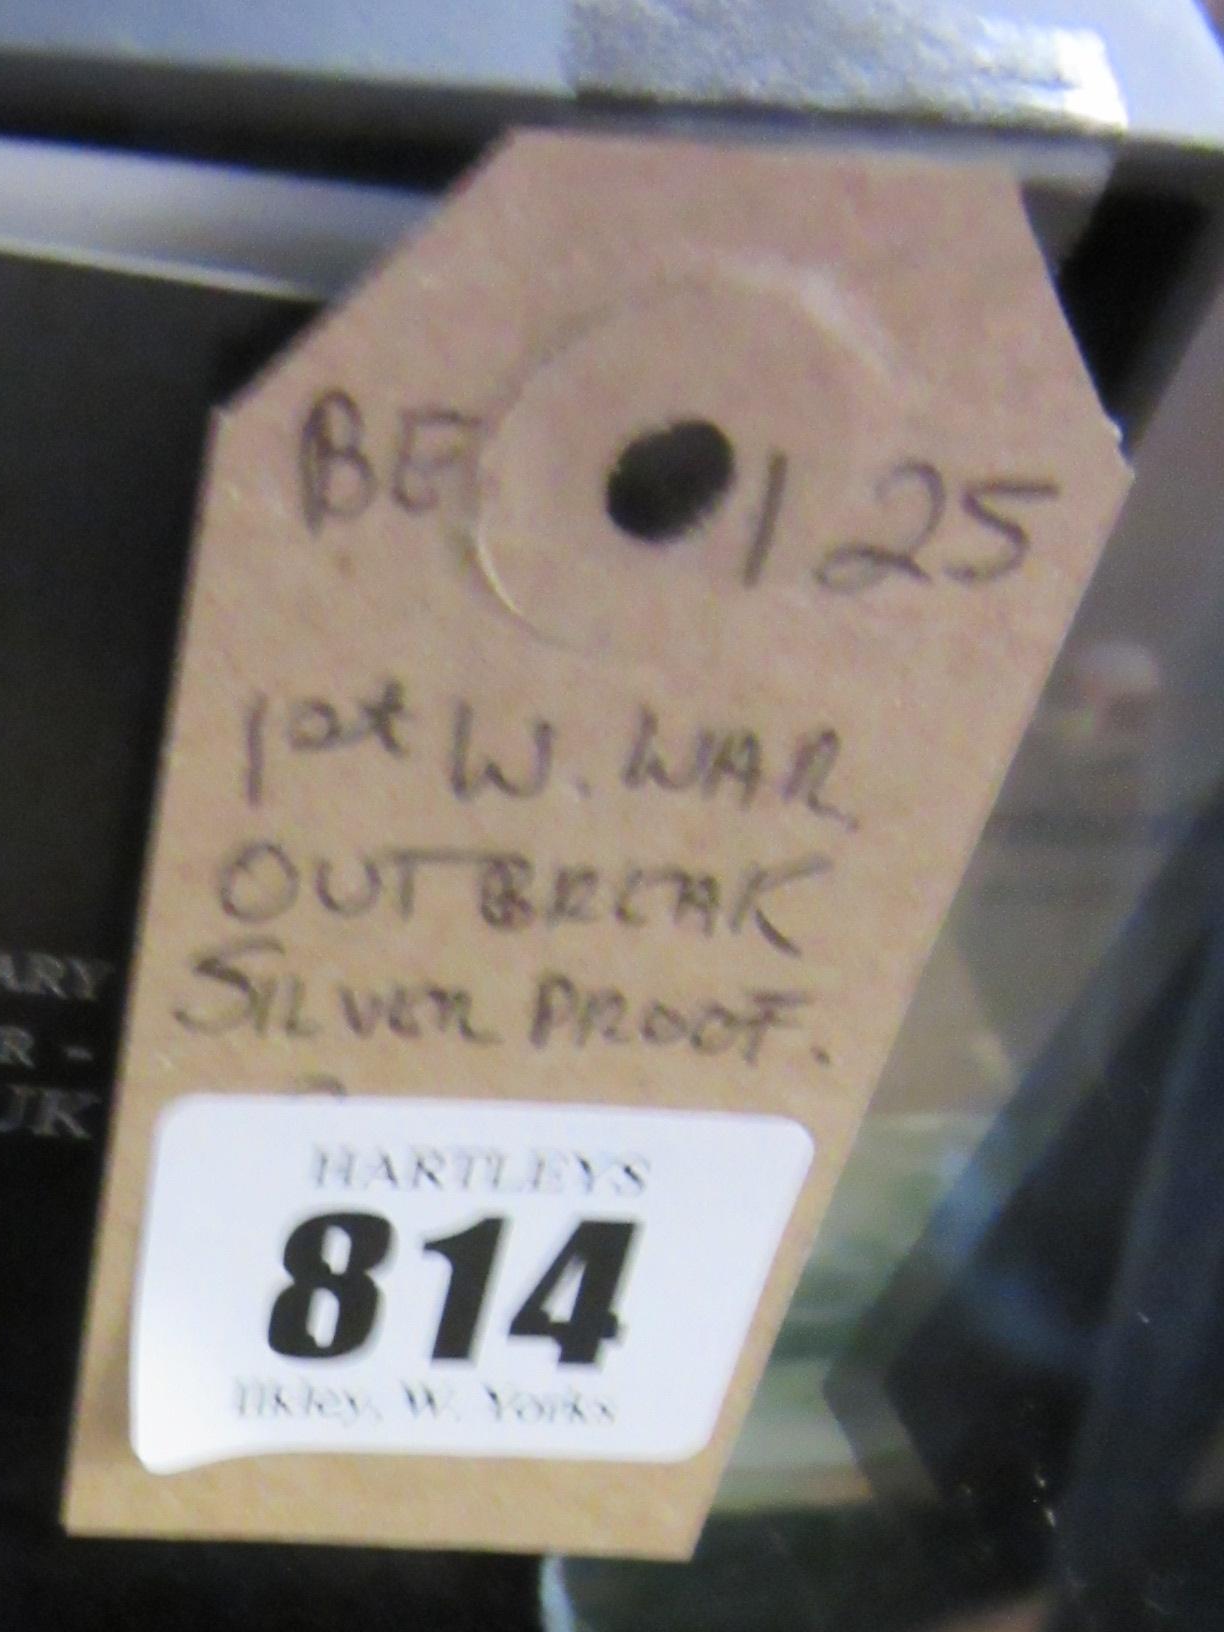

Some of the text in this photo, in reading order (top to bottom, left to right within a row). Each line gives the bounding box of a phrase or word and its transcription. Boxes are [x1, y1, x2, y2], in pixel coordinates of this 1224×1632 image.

[622, 703, 860, 833] WAR
[218, 841, 834, 956] OUTBREAK
[310, 1142, 651, 1198] HARTLEYS
[267, 1210, 640, 1367] 814
[482, 1382, 620, 1427] Yorks
